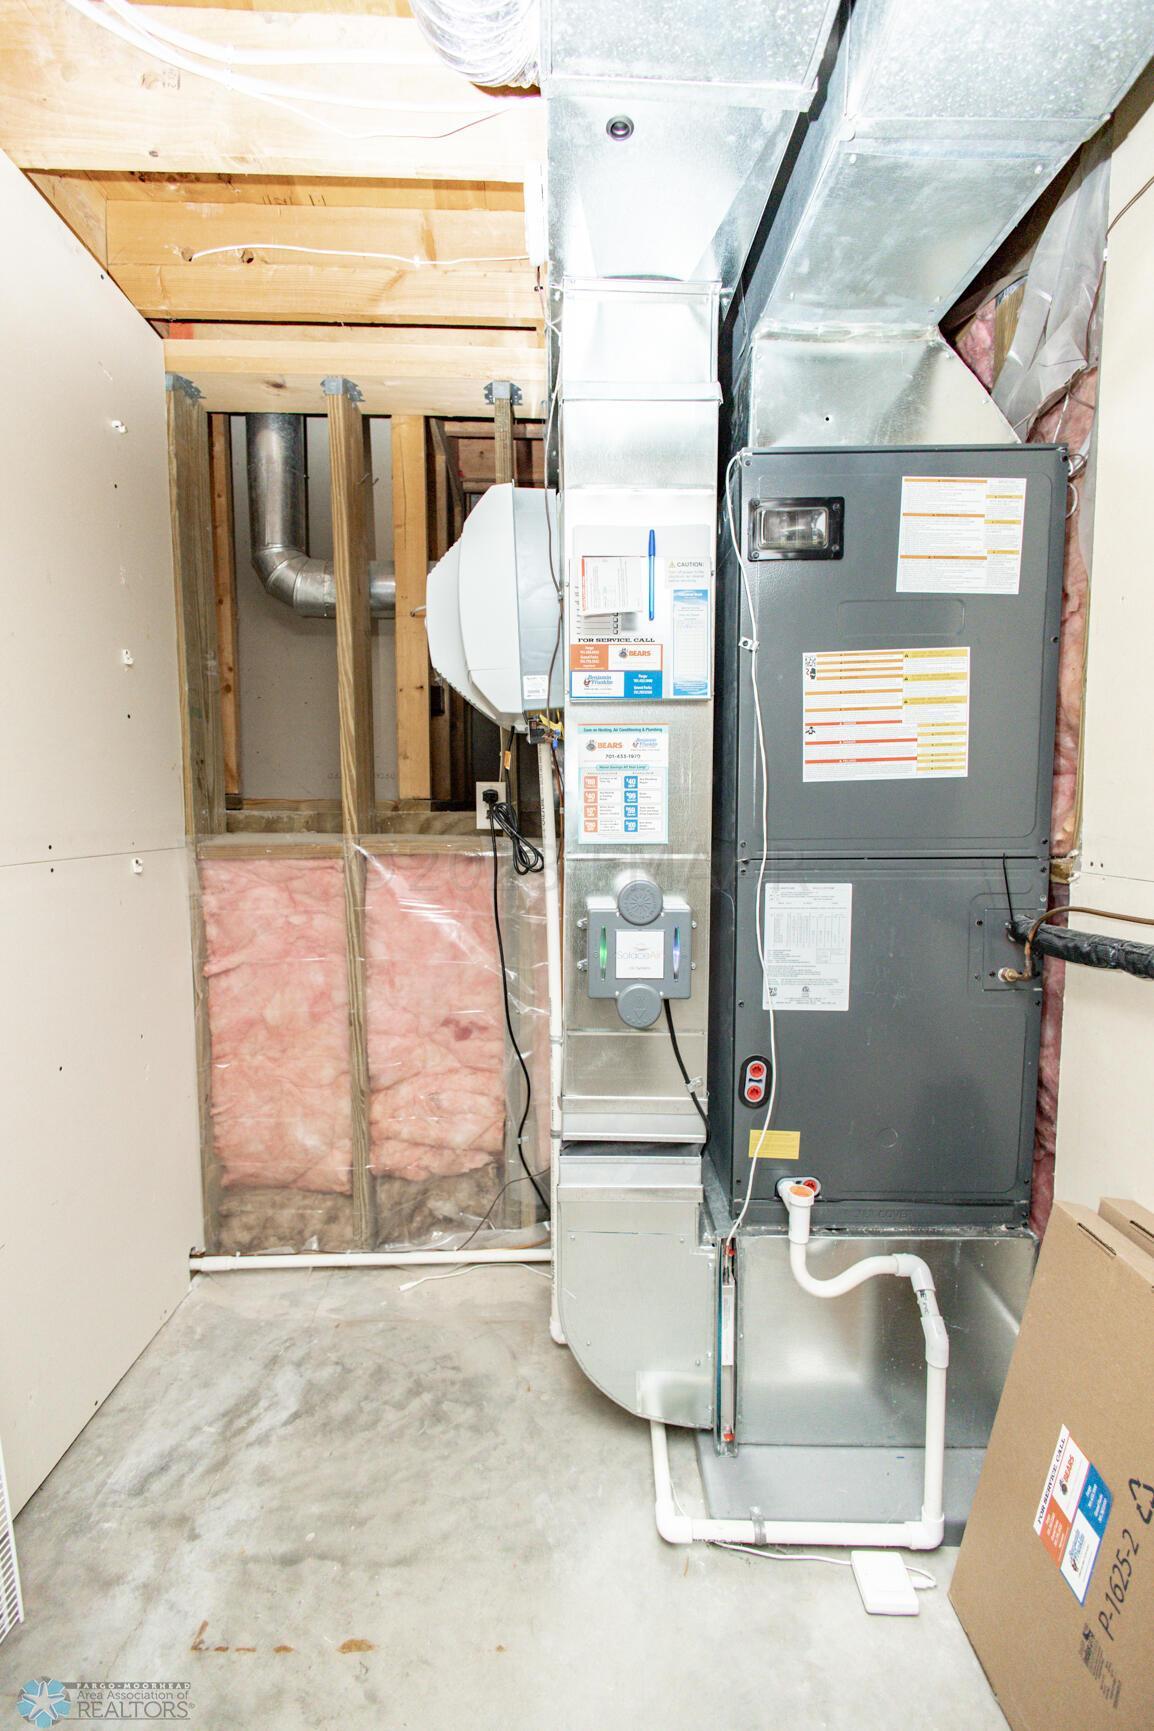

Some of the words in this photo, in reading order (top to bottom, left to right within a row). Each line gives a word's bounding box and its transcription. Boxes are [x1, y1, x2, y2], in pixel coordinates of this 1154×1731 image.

[1037, 1506, 1046, 1525] FOR
[1043, 1464, 1058, 1504] SERVICE
[1056, 1438, 1066, 1462] CALL
[1063, 1454, 1075, 1482] BEARS
[1098, 1528, 1139, 1642] P-1625-2
